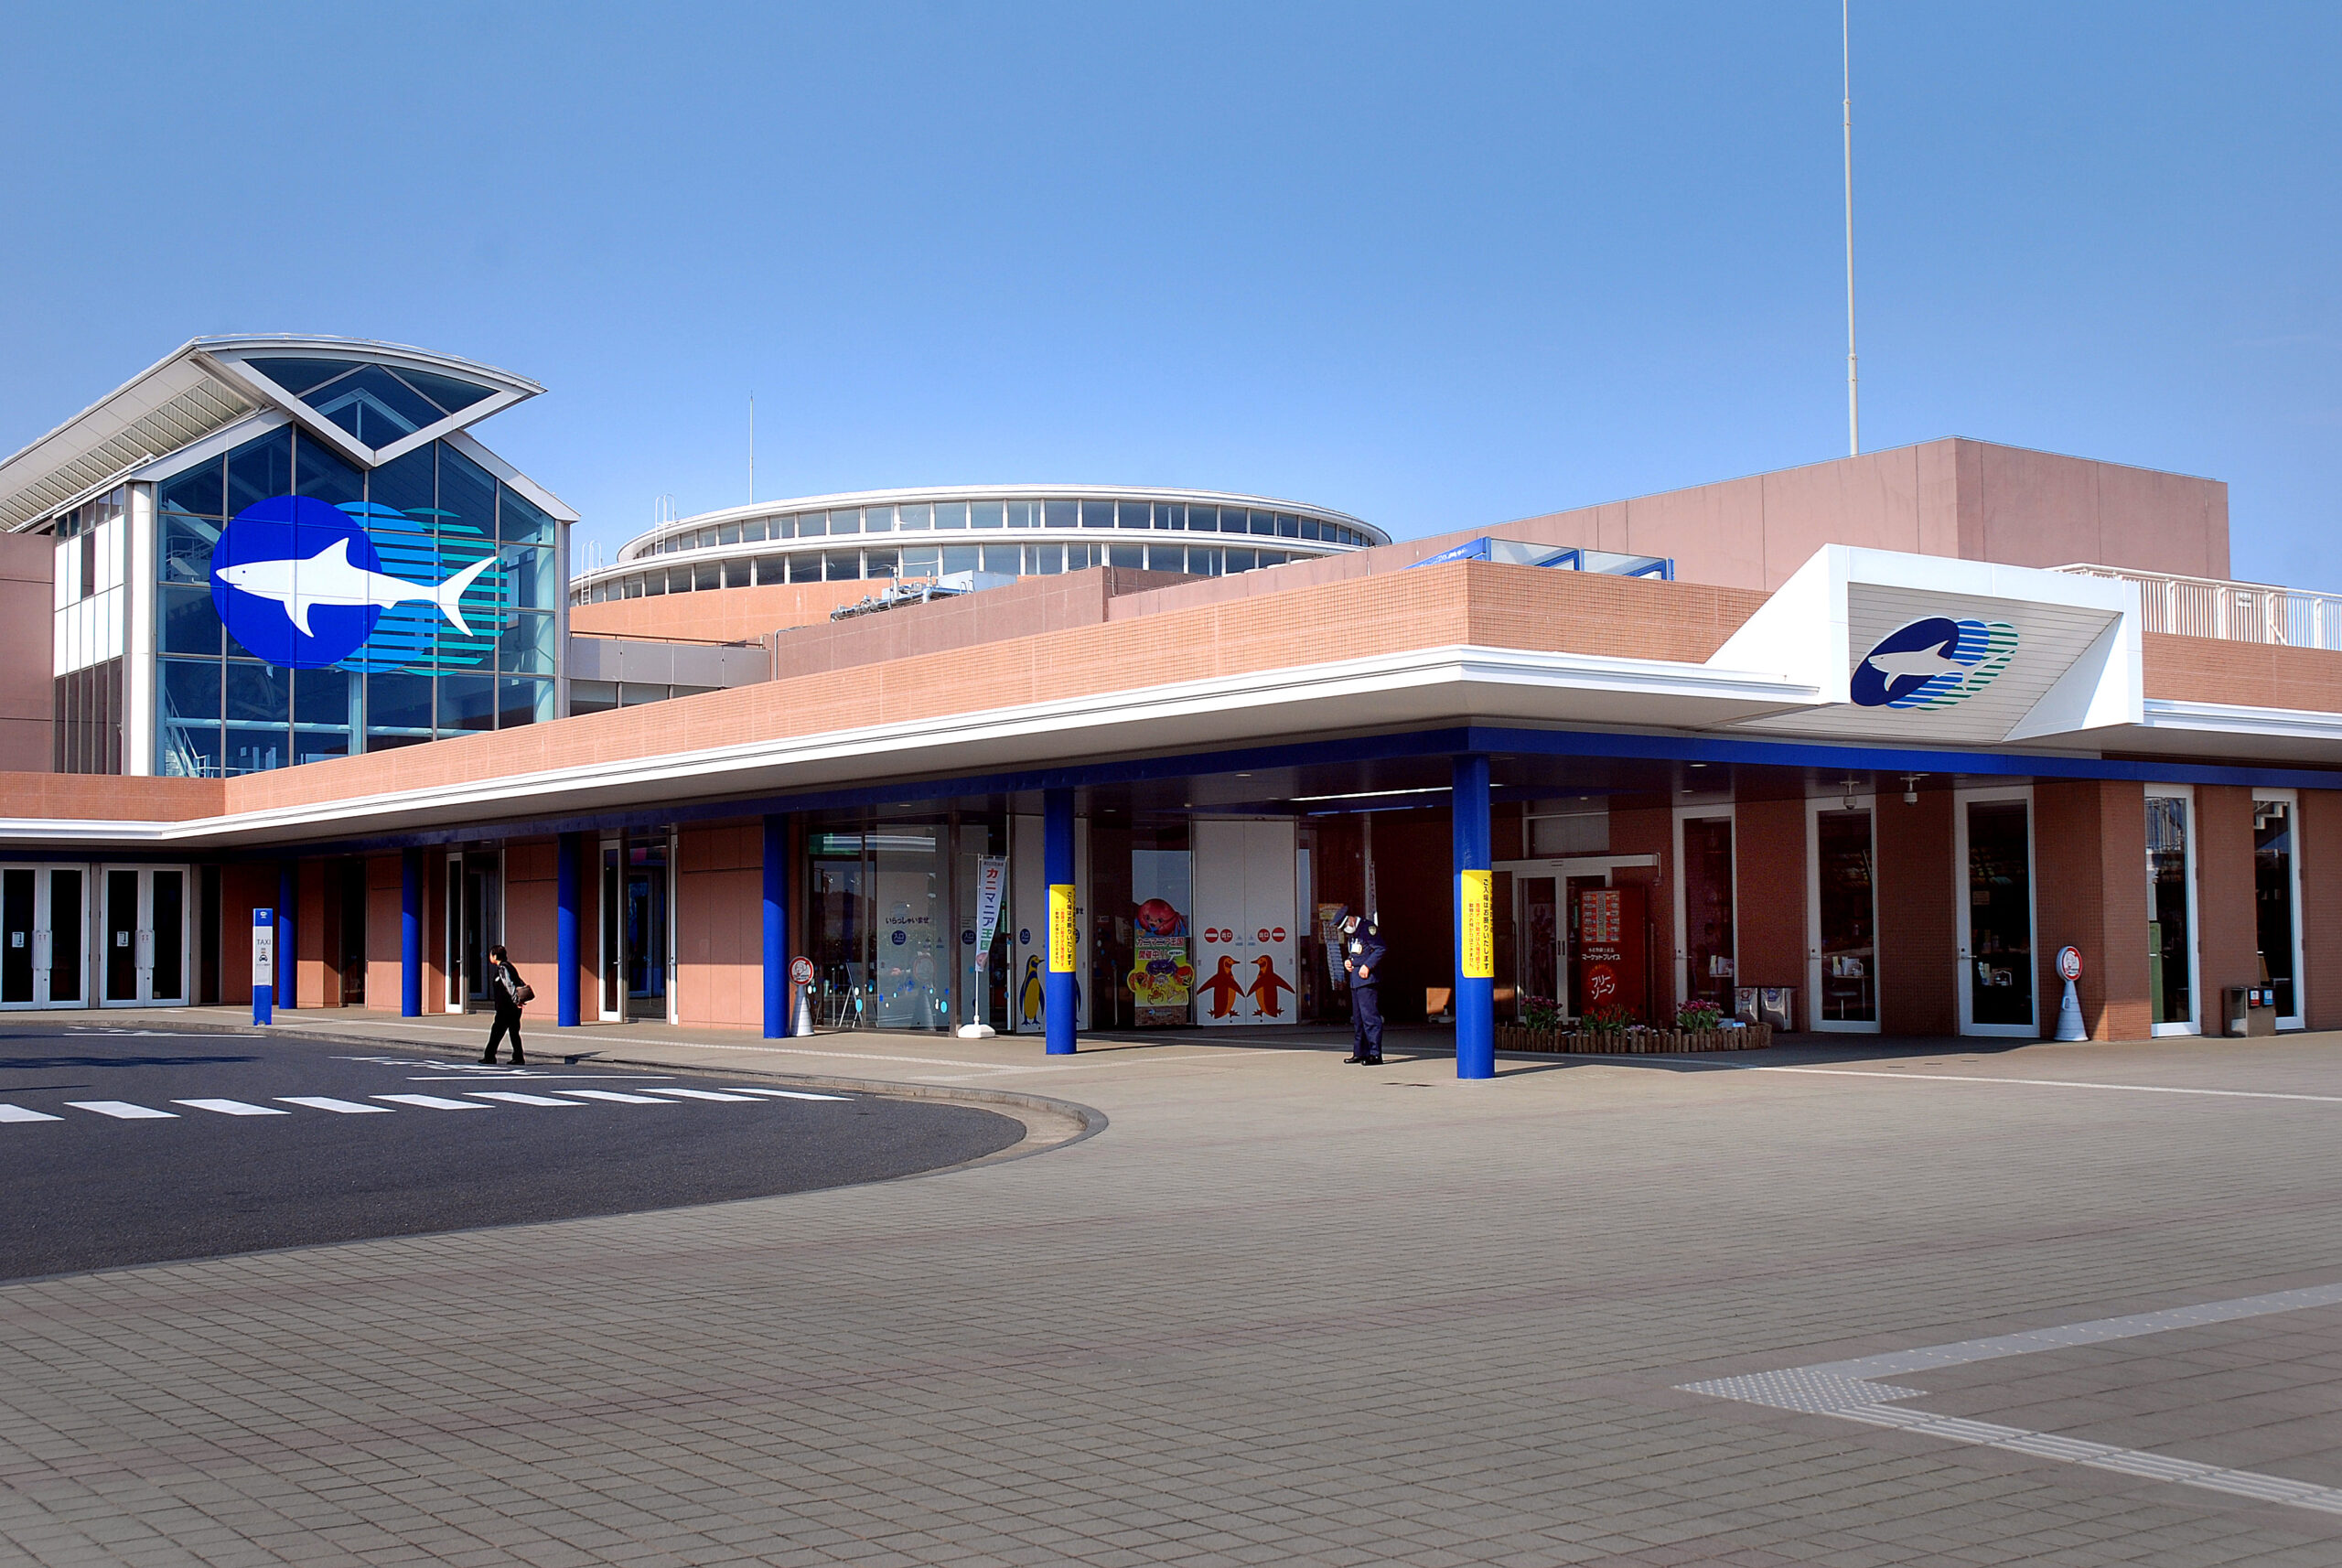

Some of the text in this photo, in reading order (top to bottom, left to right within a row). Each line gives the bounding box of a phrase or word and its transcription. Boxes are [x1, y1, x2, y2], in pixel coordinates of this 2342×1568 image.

[980, 868, 999, 950] カニマニア王国
[1136, 937, 1185, 947] カニマニア王国
[1591, 974, 1611, 988] フリー
